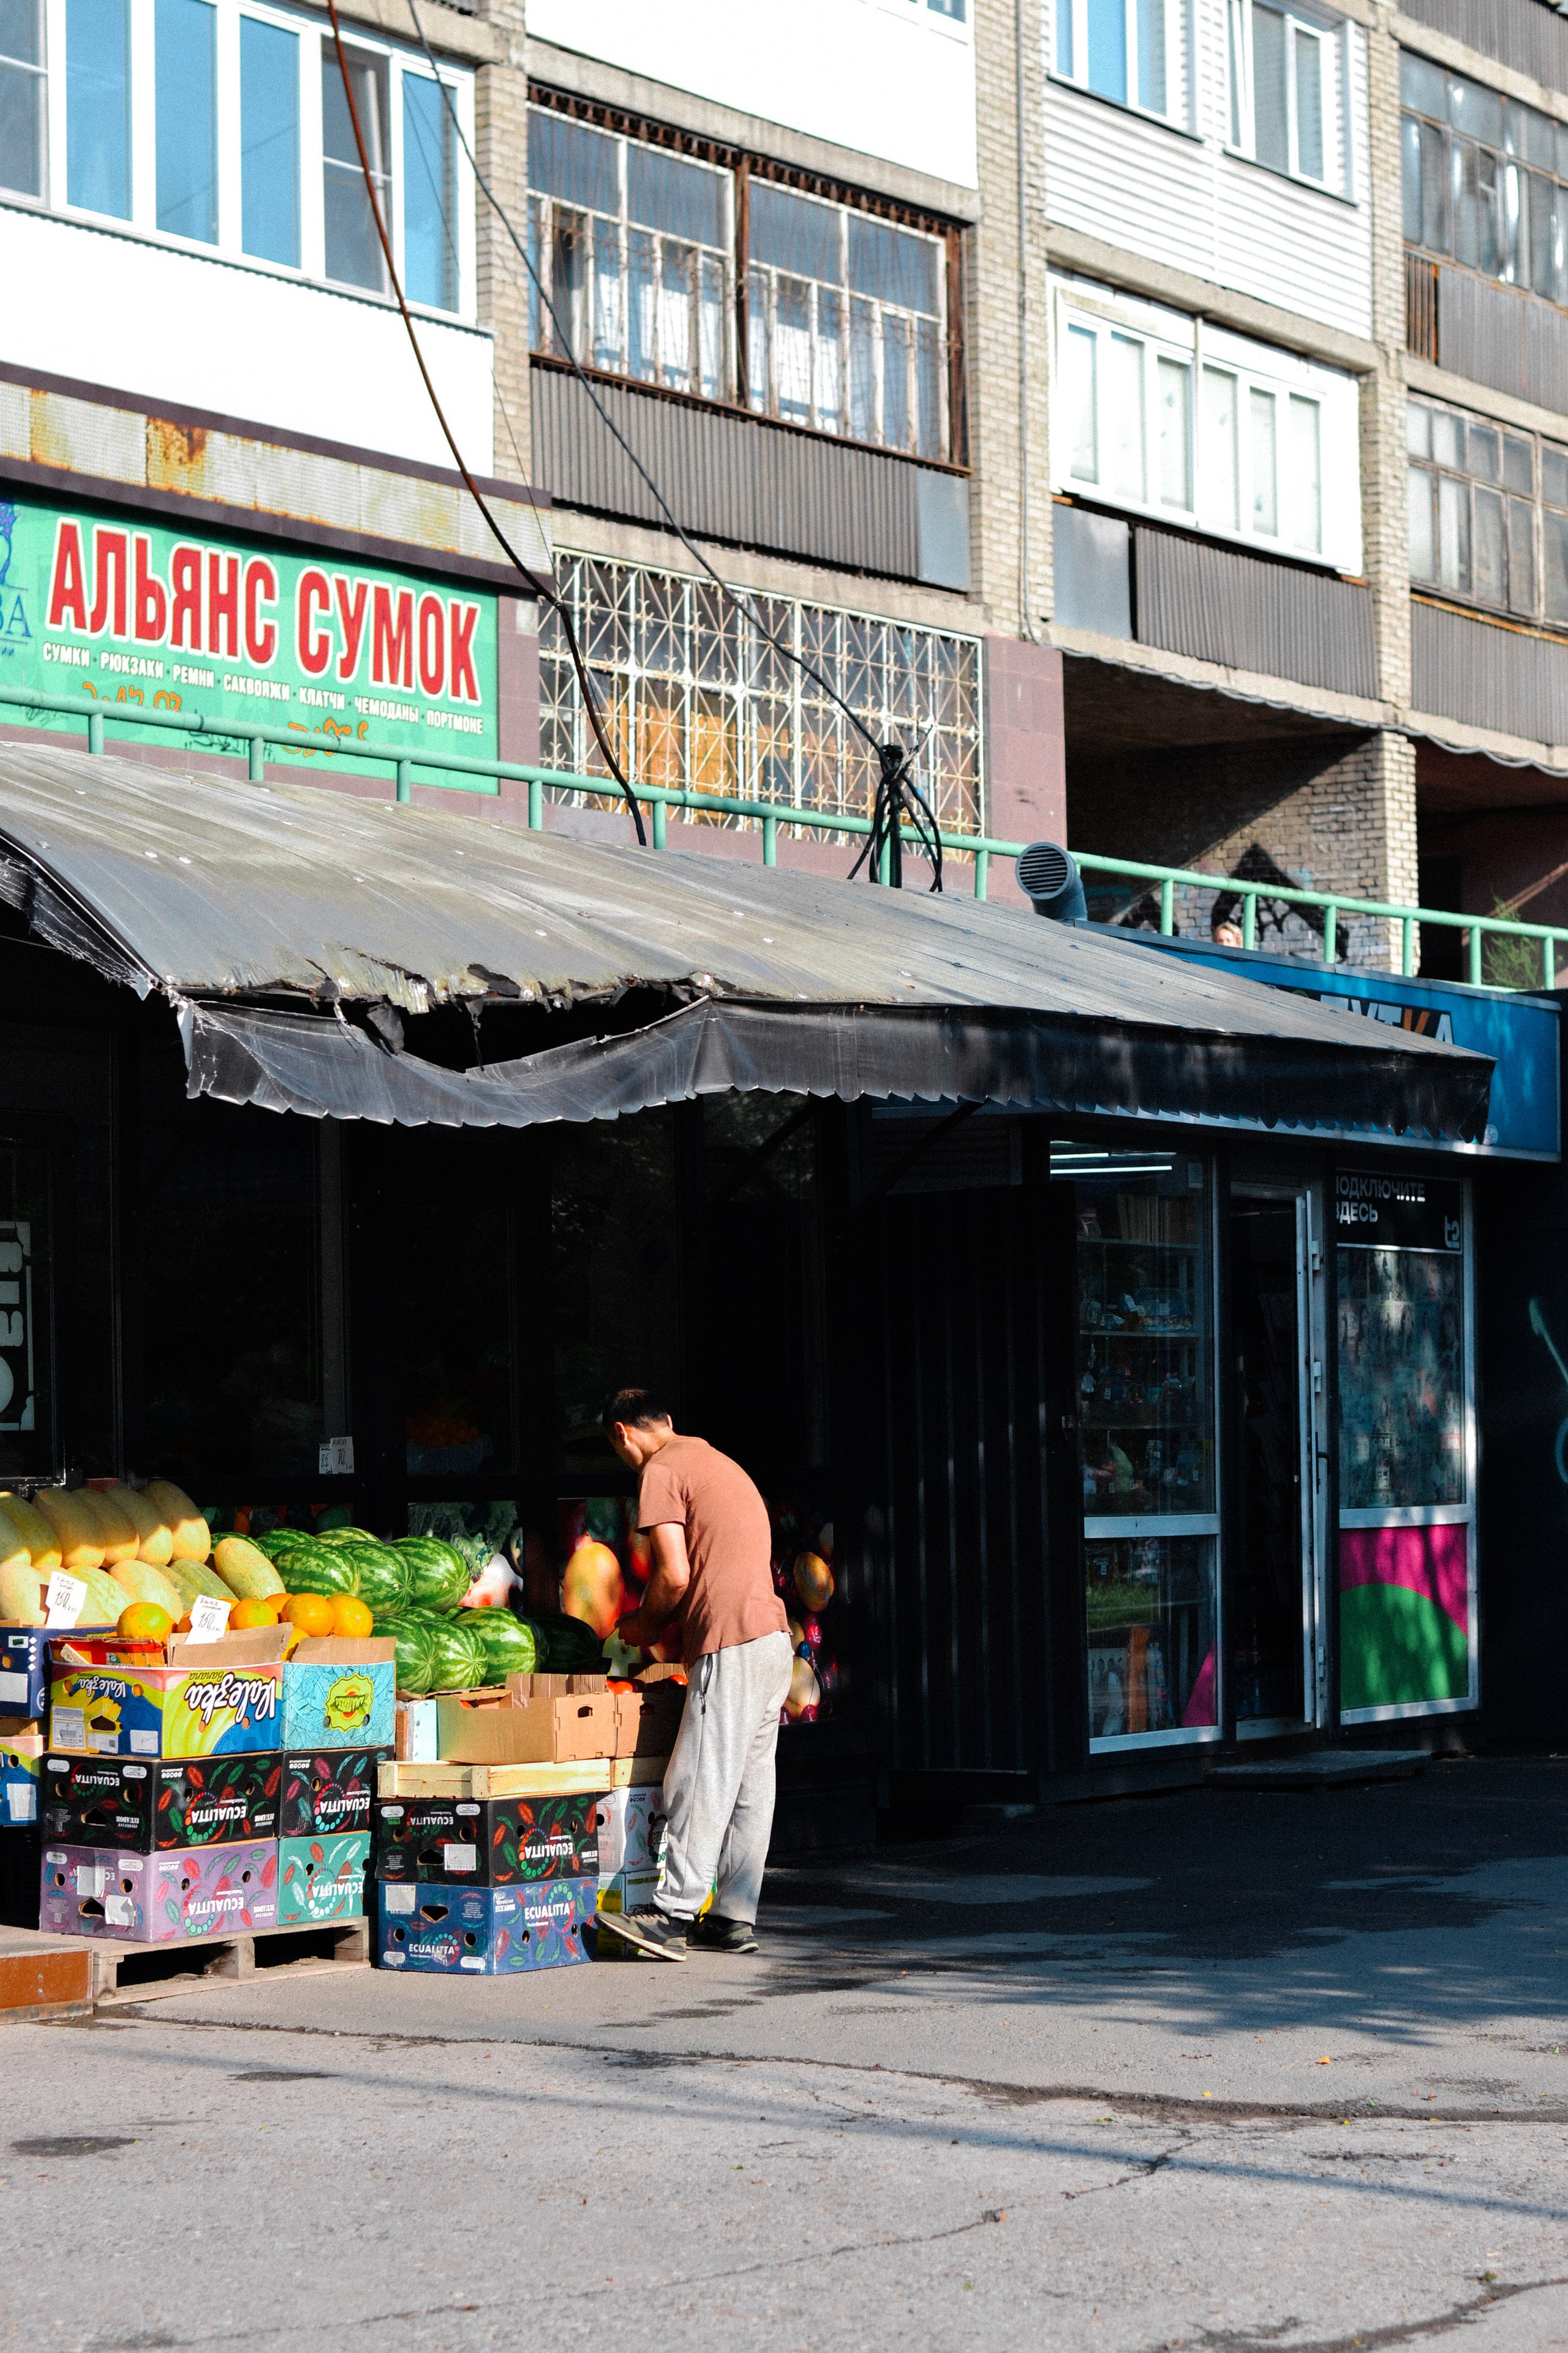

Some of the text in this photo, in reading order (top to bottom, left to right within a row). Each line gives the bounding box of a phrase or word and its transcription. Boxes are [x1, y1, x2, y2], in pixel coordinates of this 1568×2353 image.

[47, 518, 481, 705] АЛЬЯНС СУМОК
[43, 641, 90, 667] СУМКИ
[100, 651, 164, 679] РЮКЗАКИ
[173, 663, 214, 688] РЕМНИ
[223, 673, 290, 701] САКВОЯЖИ
[299, 686, 345, 710] КЛАТЧИ
[354, 696, 419, 723] ЧЕМОДАНЫ
[426, 709, 484, 735] ПОРТМОНЕ
[1336, 1175, 1426, 1202] ОДКЛЮЧИТЕ
[188, 1671, 224, 1683] Banana
[77, 1675, 126, 1698] Valezka
[184, 1672, 276, 1724] Valezka
[75, 1774, 120, 1786] ECUALITTA
[191, 1805, 247, 1824] ECUALITTA
[320, 1797, 371, 1814] ECUALITTA
[410, 1816, 454, 1826] ECUALITTA
[525, 1841, 573, 1859] ECUALITTA
[312, 1881, 364, 1898] ECUALITTA
[187, 1897, 244, 1916] ECUALITTA
[524, 1903, 570, 1920] ECUALITTA
[409, 1943, 454, 1955] ECUALITTA
